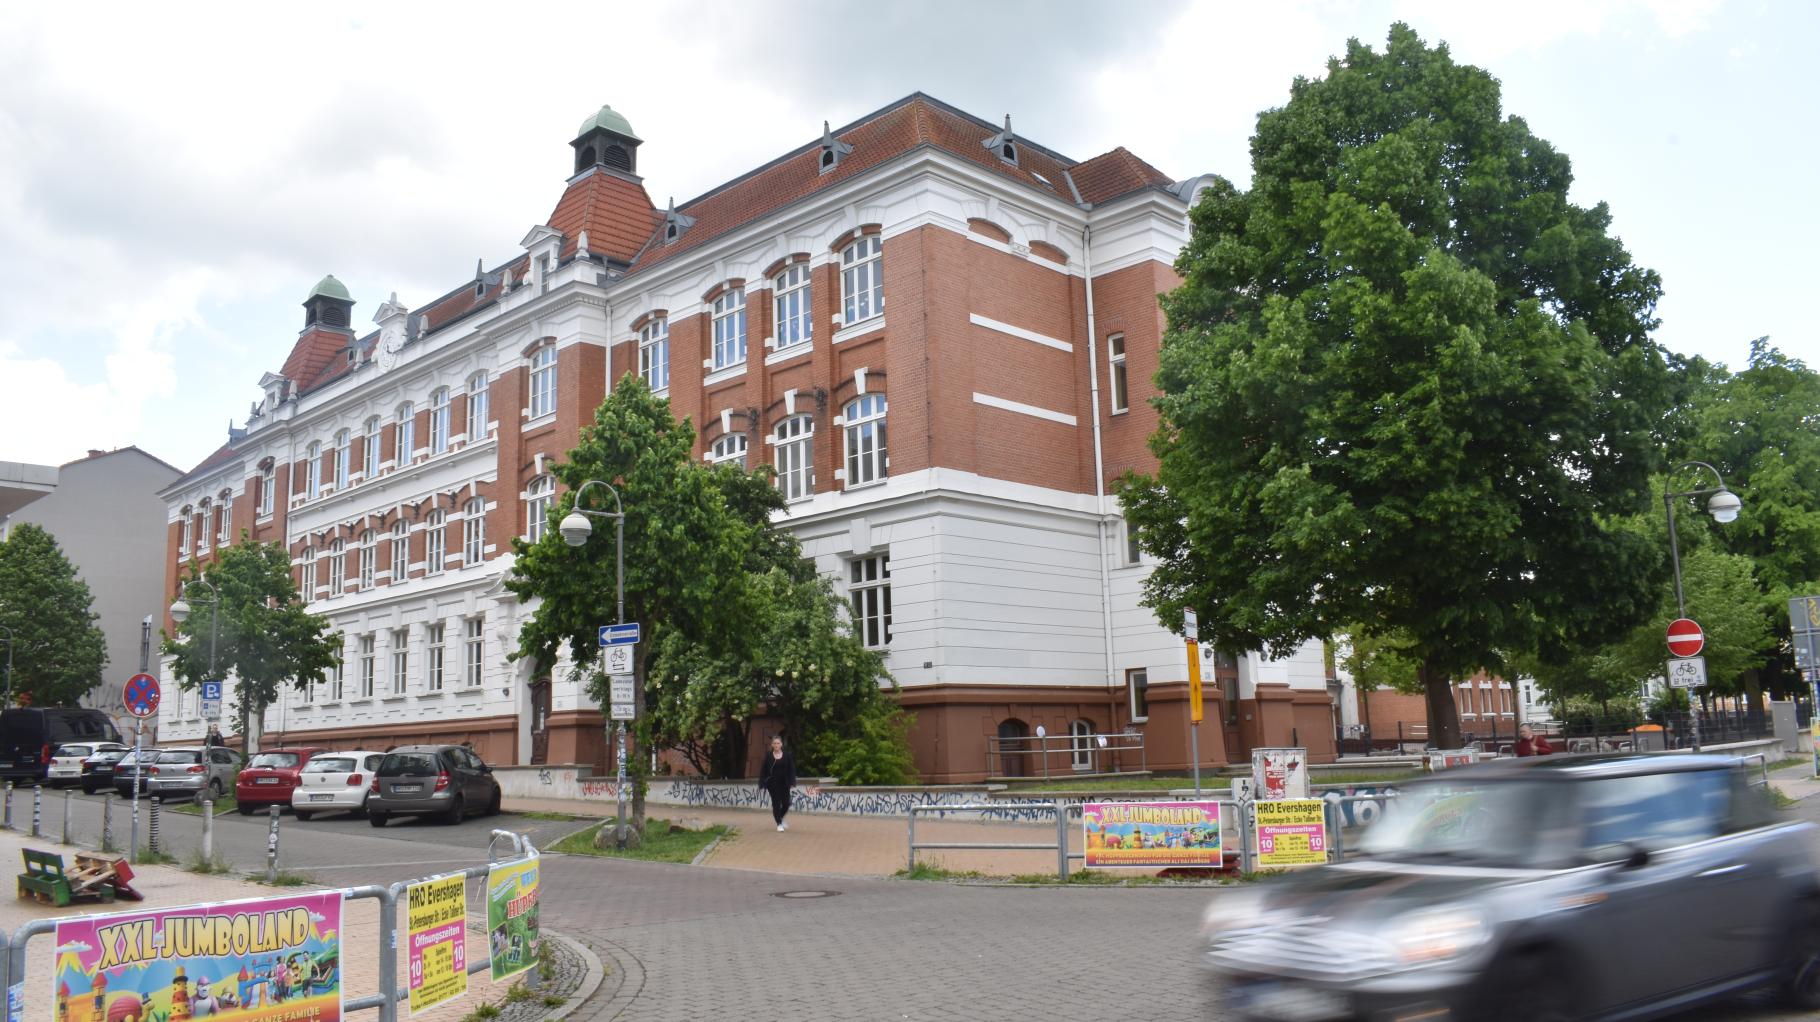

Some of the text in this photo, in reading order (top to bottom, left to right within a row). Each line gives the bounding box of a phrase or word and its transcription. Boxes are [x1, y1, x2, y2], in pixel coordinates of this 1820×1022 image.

[206, 684, 217, 698] P
[1101, 805, 1202, 825] XXL JUMBOLAND
[1257, 802, 1322, 815] HRO Evershagen
[1264, 826, 1317, 835] Öffnungszeiten
[1260, 839, 1273, 849] 10
[1310, 837, 1322, 847] 10
[409, 886, 425, 910] HRO
[428, 882, 464, 904] Evershagen
[98, 907, 311, 970] XXL JUMBOLAND
[415, 925, 460, 948] Öffnungszeiten
[454, 945, 464, 962] 10
[410, 959, 422, 978] 10
[284, 1006, 321, 1022] FAMILIE
